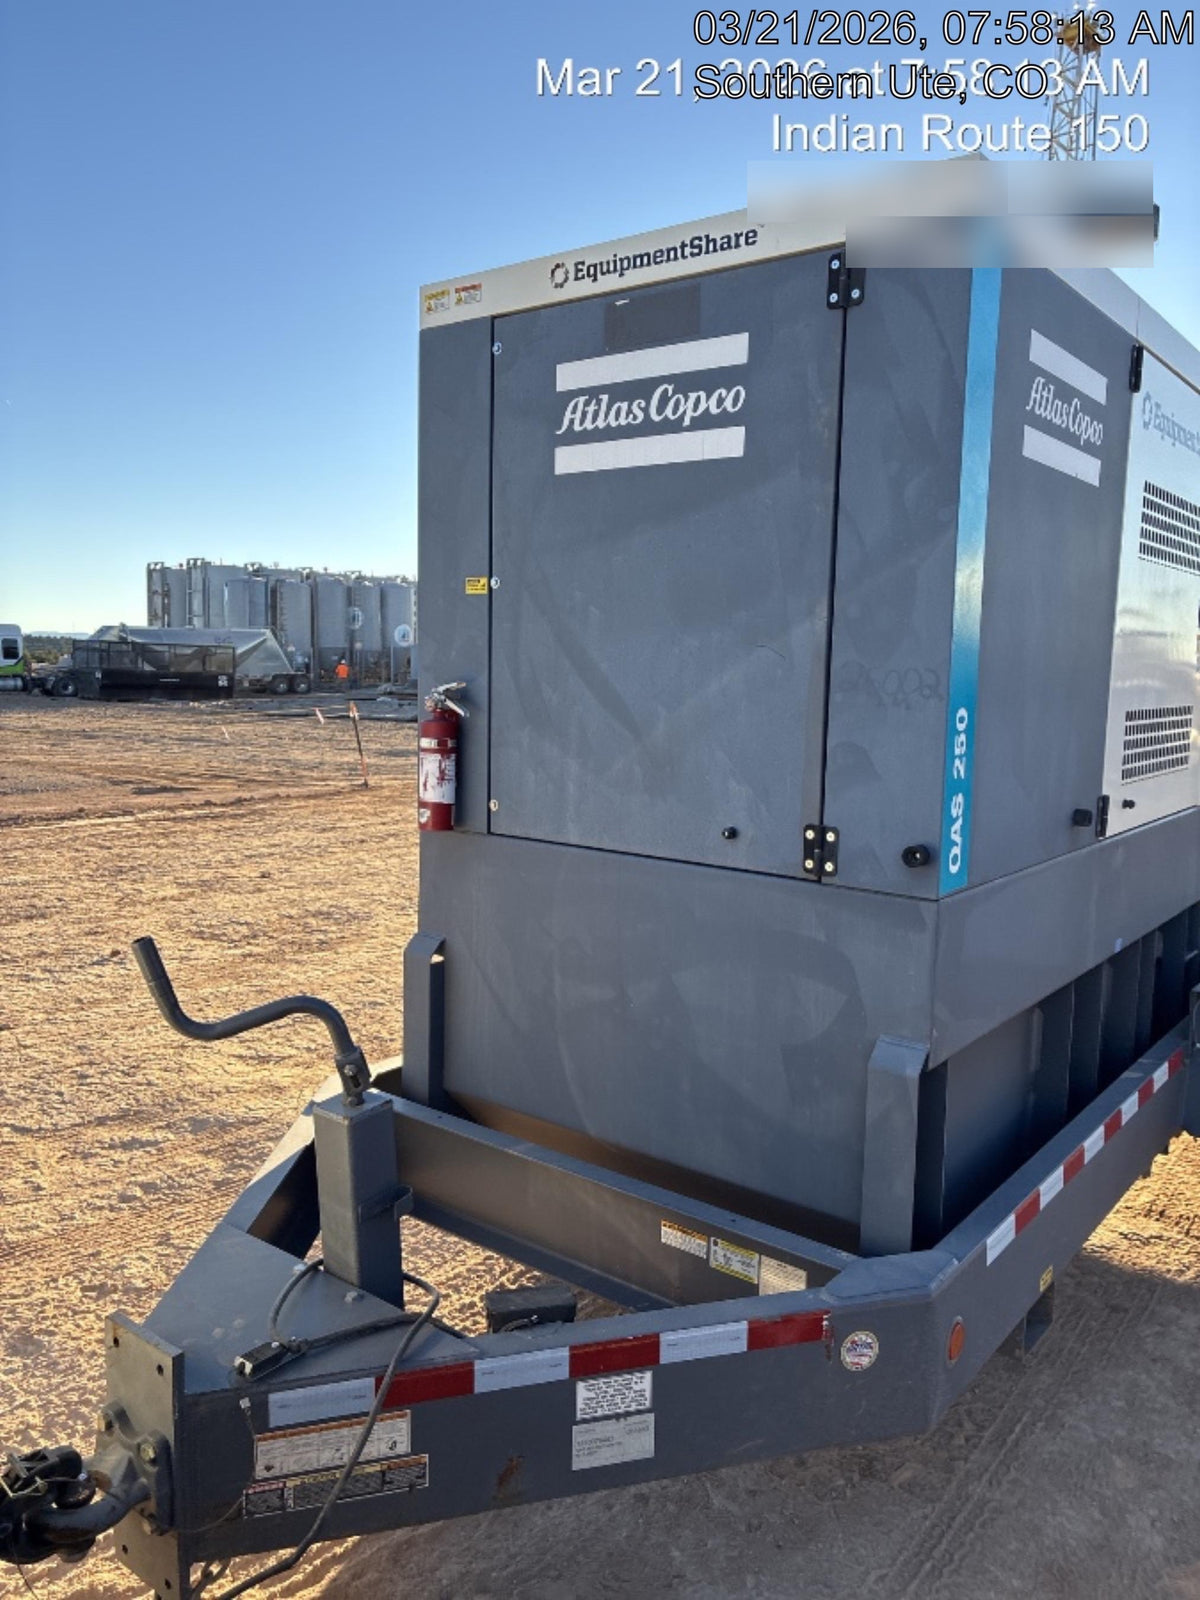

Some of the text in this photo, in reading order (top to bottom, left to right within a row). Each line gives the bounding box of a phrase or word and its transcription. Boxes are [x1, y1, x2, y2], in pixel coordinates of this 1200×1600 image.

[573, 228, 758, 283] EquipmentShare
[556, 383, 746, 435] Atlas Copco
[1026, 376, 1104, 446] Atlas Copco
[948, 706, 968, 875] QAS 250
